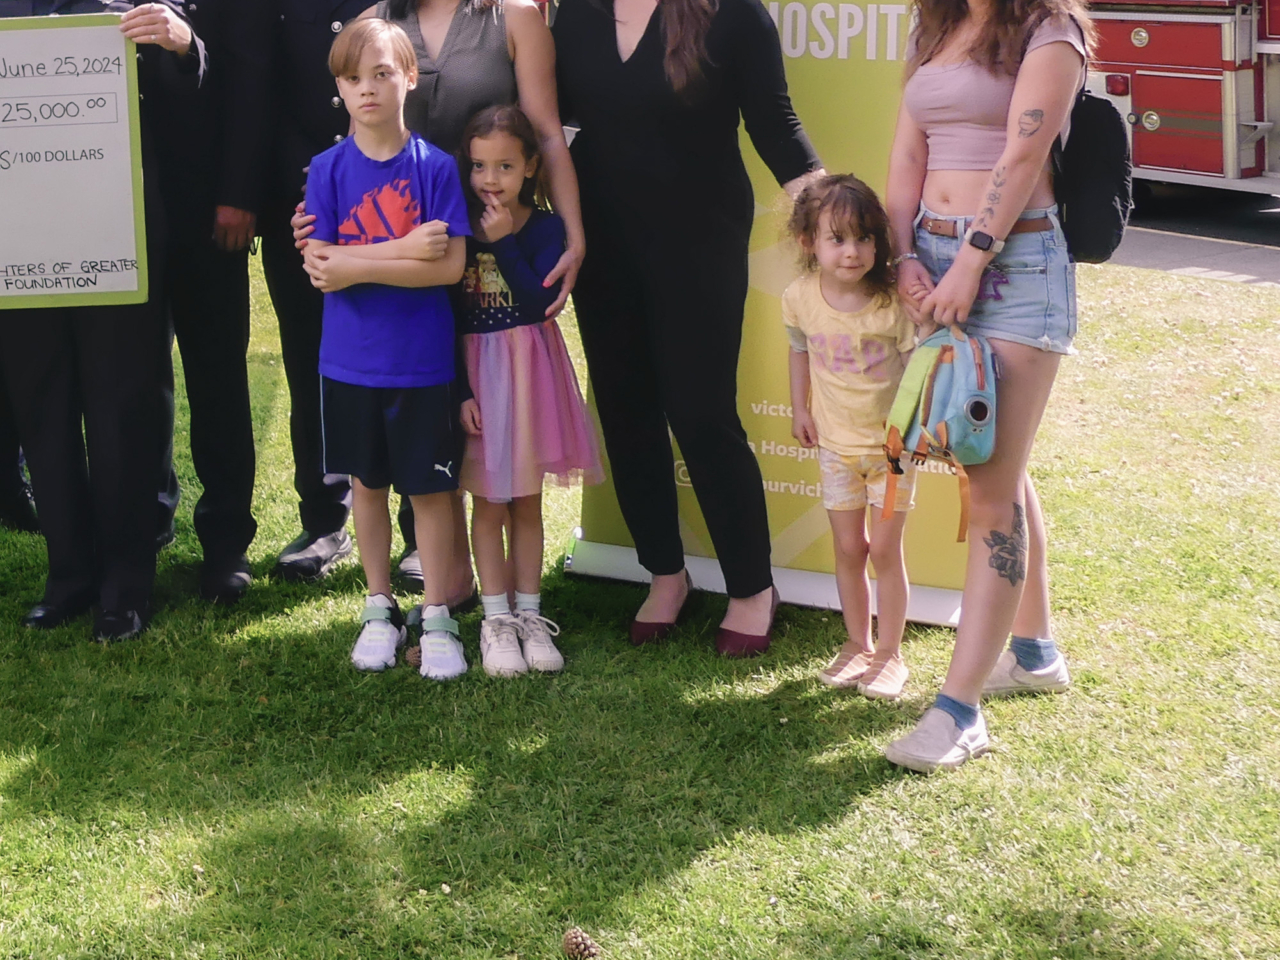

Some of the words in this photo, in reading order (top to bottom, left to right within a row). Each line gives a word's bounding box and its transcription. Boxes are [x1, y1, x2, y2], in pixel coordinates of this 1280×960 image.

[769, 1, 908, 61] OSPIT
[12, 151, 41, 164] /100
[44, 149, 104, 162] DOLLARS
[53, 262, 72, 274] OF
[80, 259, 139, 273] GREATER
[5, 274, 98, 290] FOUNDATION
